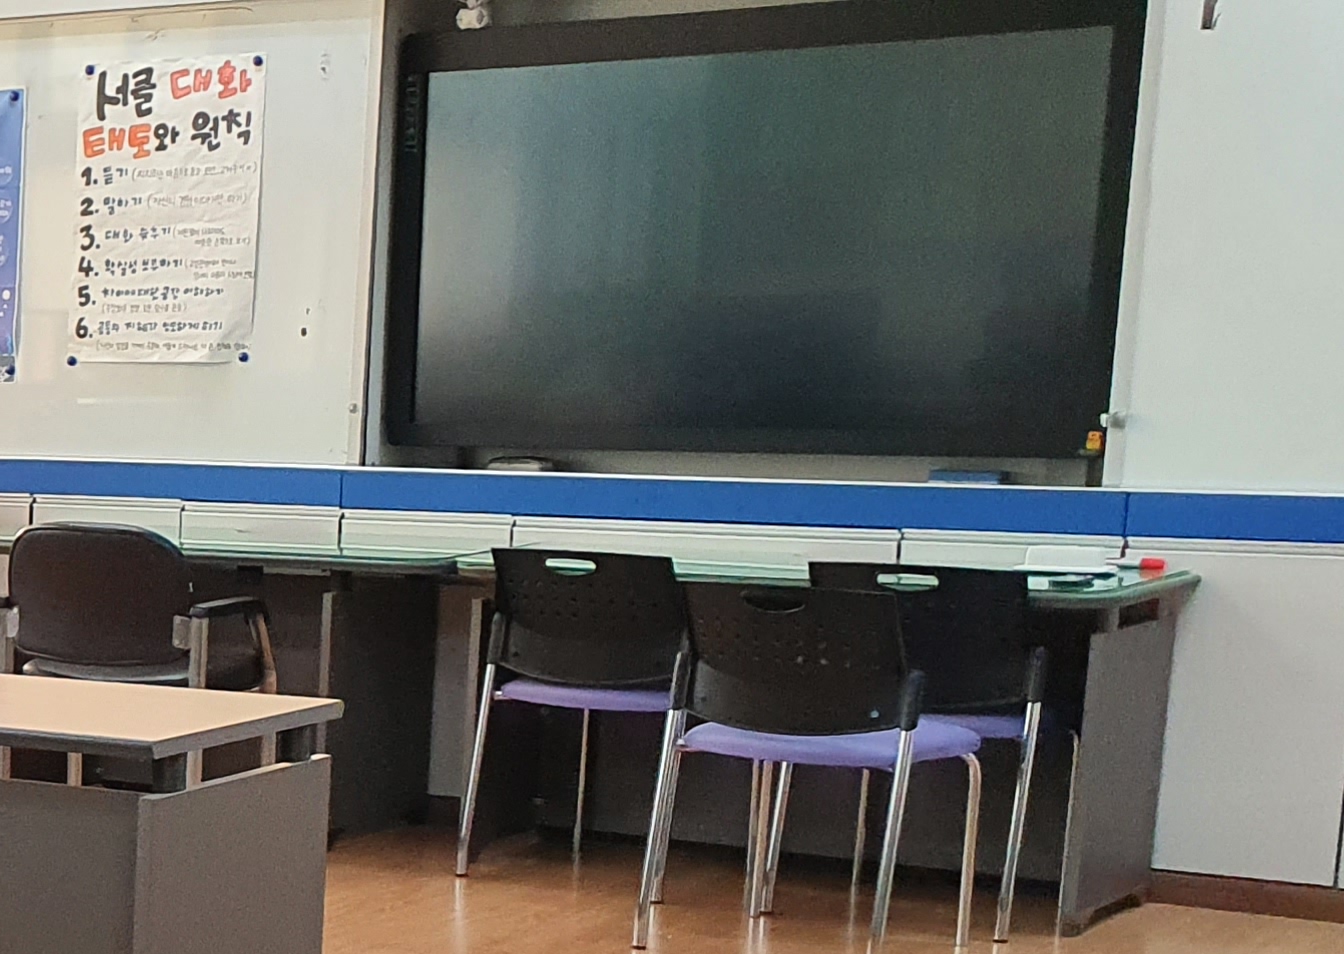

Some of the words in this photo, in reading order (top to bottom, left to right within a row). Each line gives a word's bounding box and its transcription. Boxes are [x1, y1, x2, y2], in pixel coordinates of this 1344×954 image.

[96, 66, 157, 121] 서클
[170, 60, 252, 100] 대화
[83, 123, 180, 159] 태도와
[190, 109, 252, 152] 원칙
[80, 166, 98, 186] 1.
[103, 166, 128, 185] 듣기
[80, 197, 100, 217] 2.
[103, 196, 142, 215] 말하기
[79, 224, 101, 251] 3.
[78, 256, 99, 278] 4.
[78, 285, 97, 307] 5.
[75, 317, 93, 339] 6.
